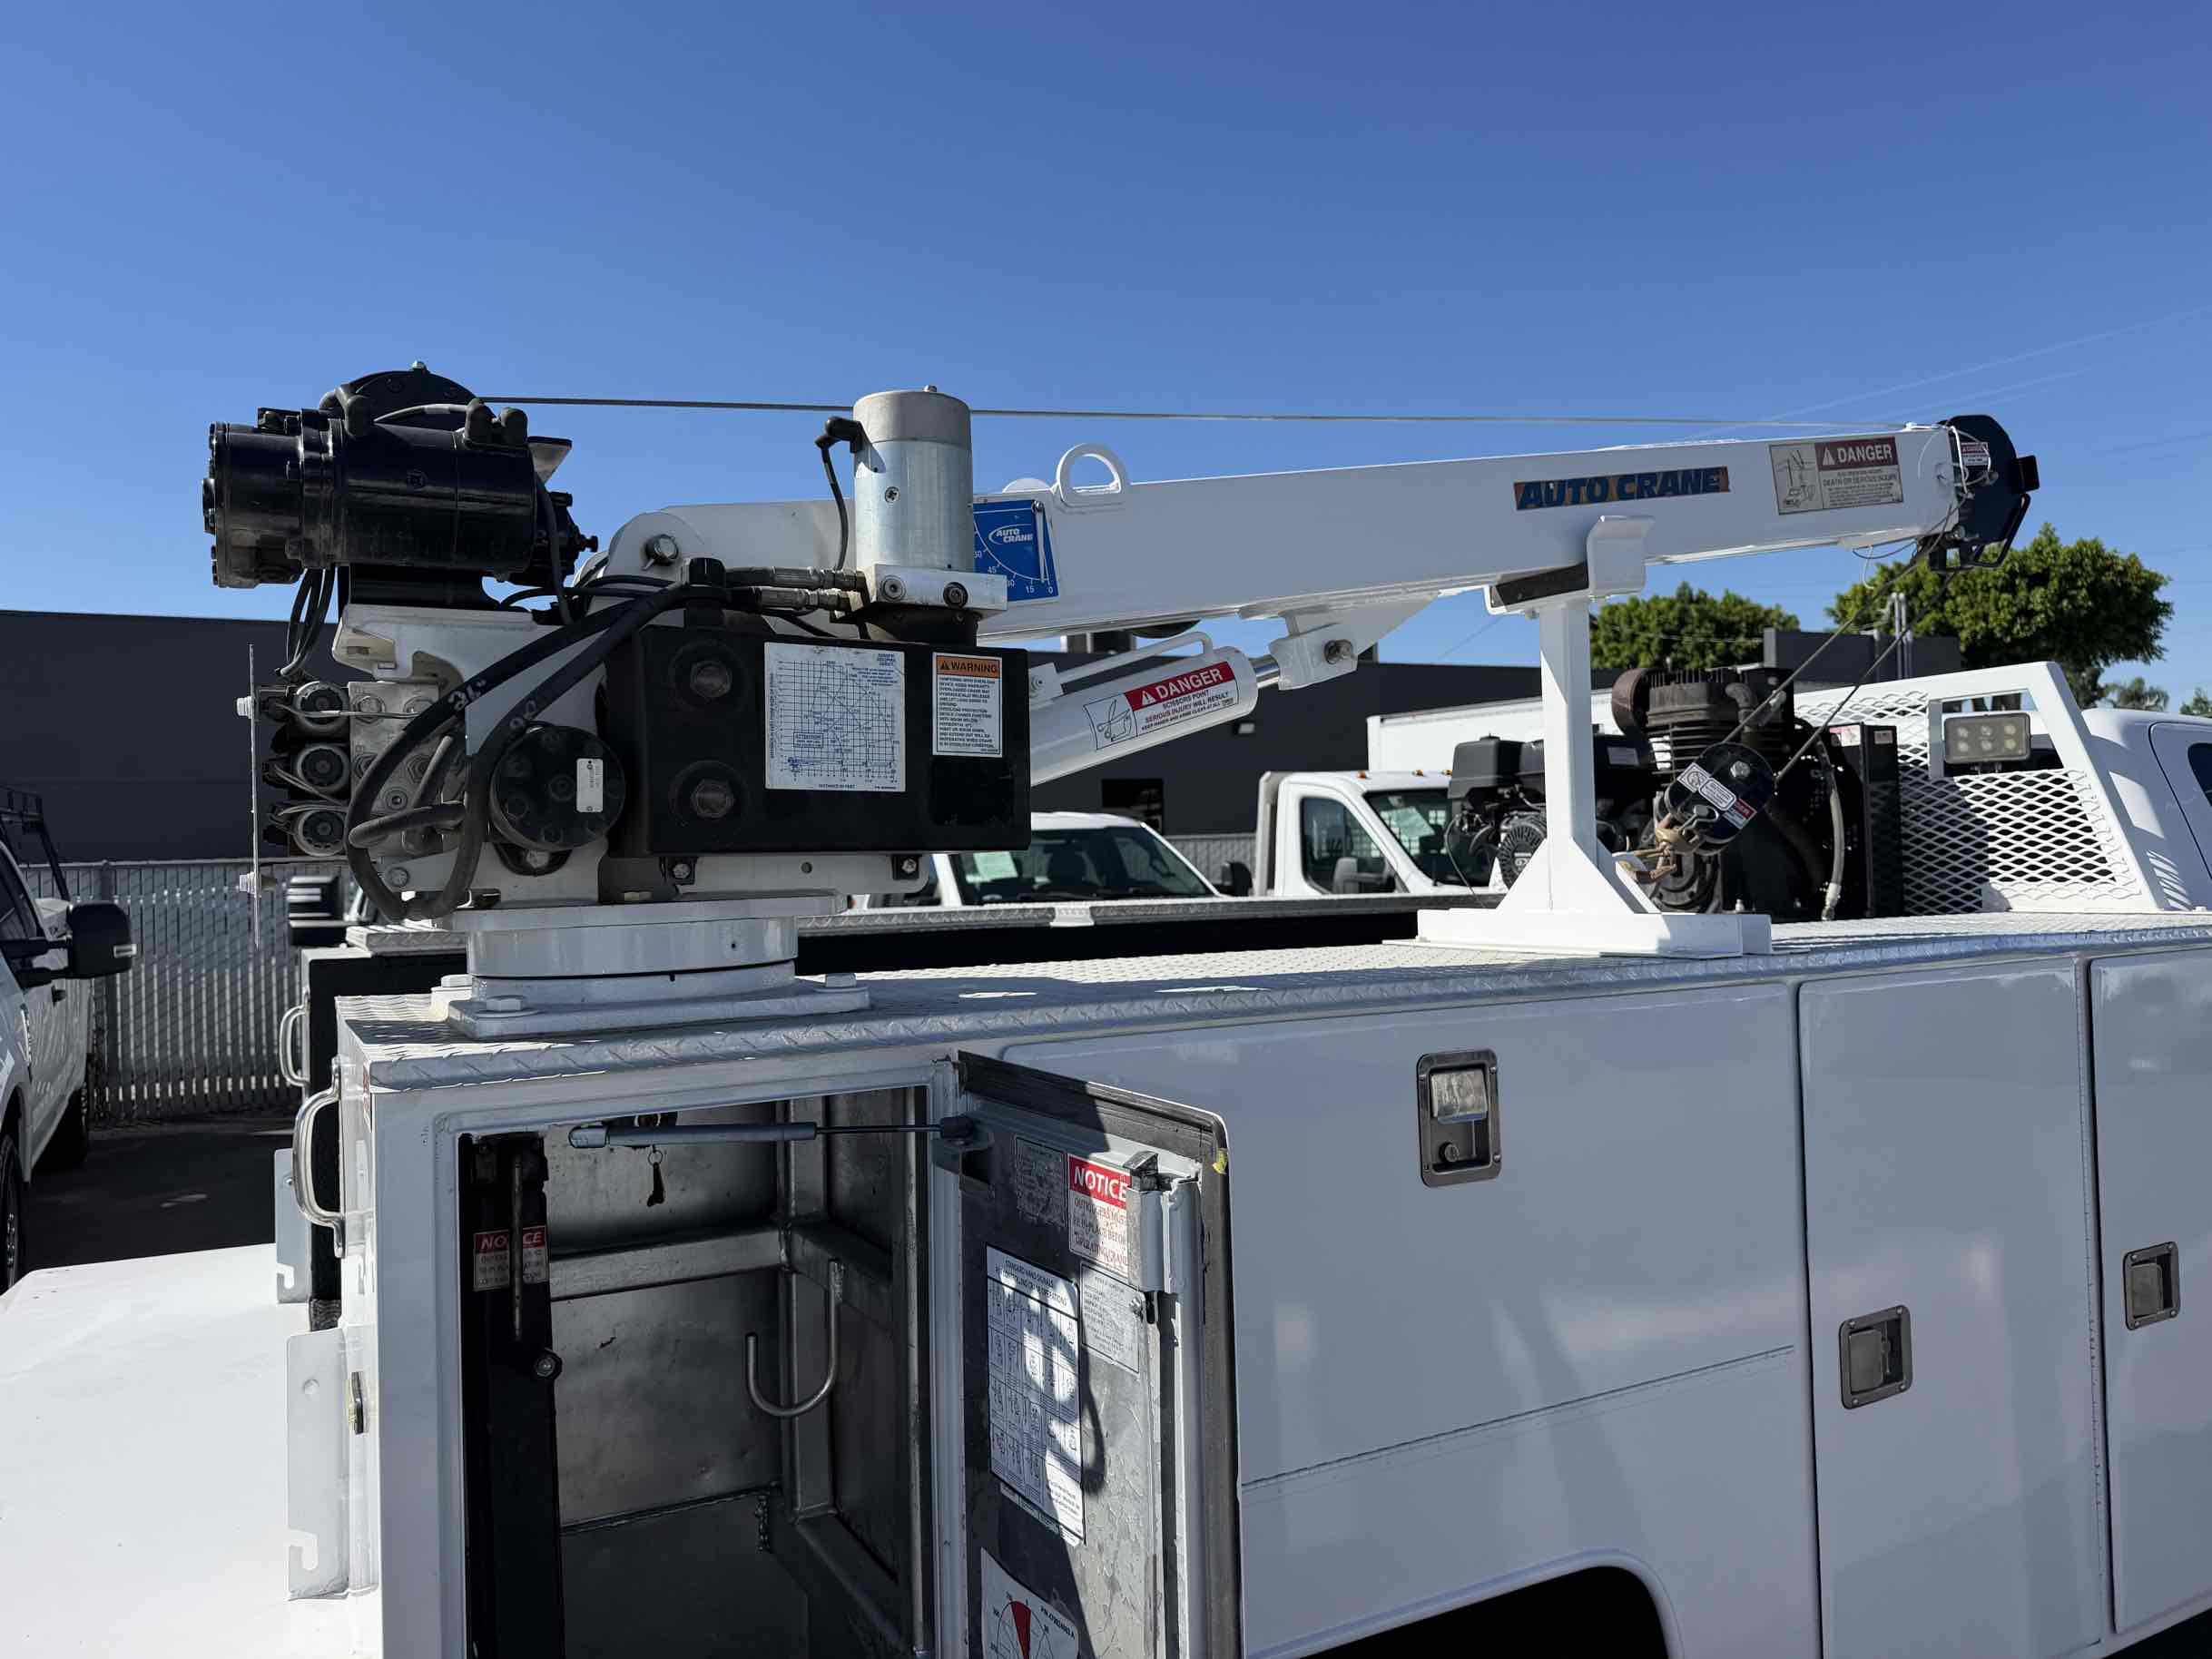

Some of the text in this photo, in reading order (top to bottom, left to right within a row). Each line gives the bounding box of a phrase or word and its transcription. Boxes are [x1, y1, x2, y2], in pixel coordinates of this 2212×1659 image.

[1836, 444, 1892, 464] DANGER
[1519, 467, 1723, 509] AUTO CRANE
[996, 528, 1020, 537] AUTO
[988, 565, 998, 574] 45
[1026, 585, 1035, 594] 15
[1047, 585, 1054, 594] 0
[950, 660, 998, 673] WARNING
[1155, 668, 1224, 699] DANGER
[1191, 690, 1209, 702] POINT
[1193, 697, 1207, 710] WILL
[1074, 1165, 1128, 1203] NOTICE
[480, 1232, 542, 1250] NOCE
